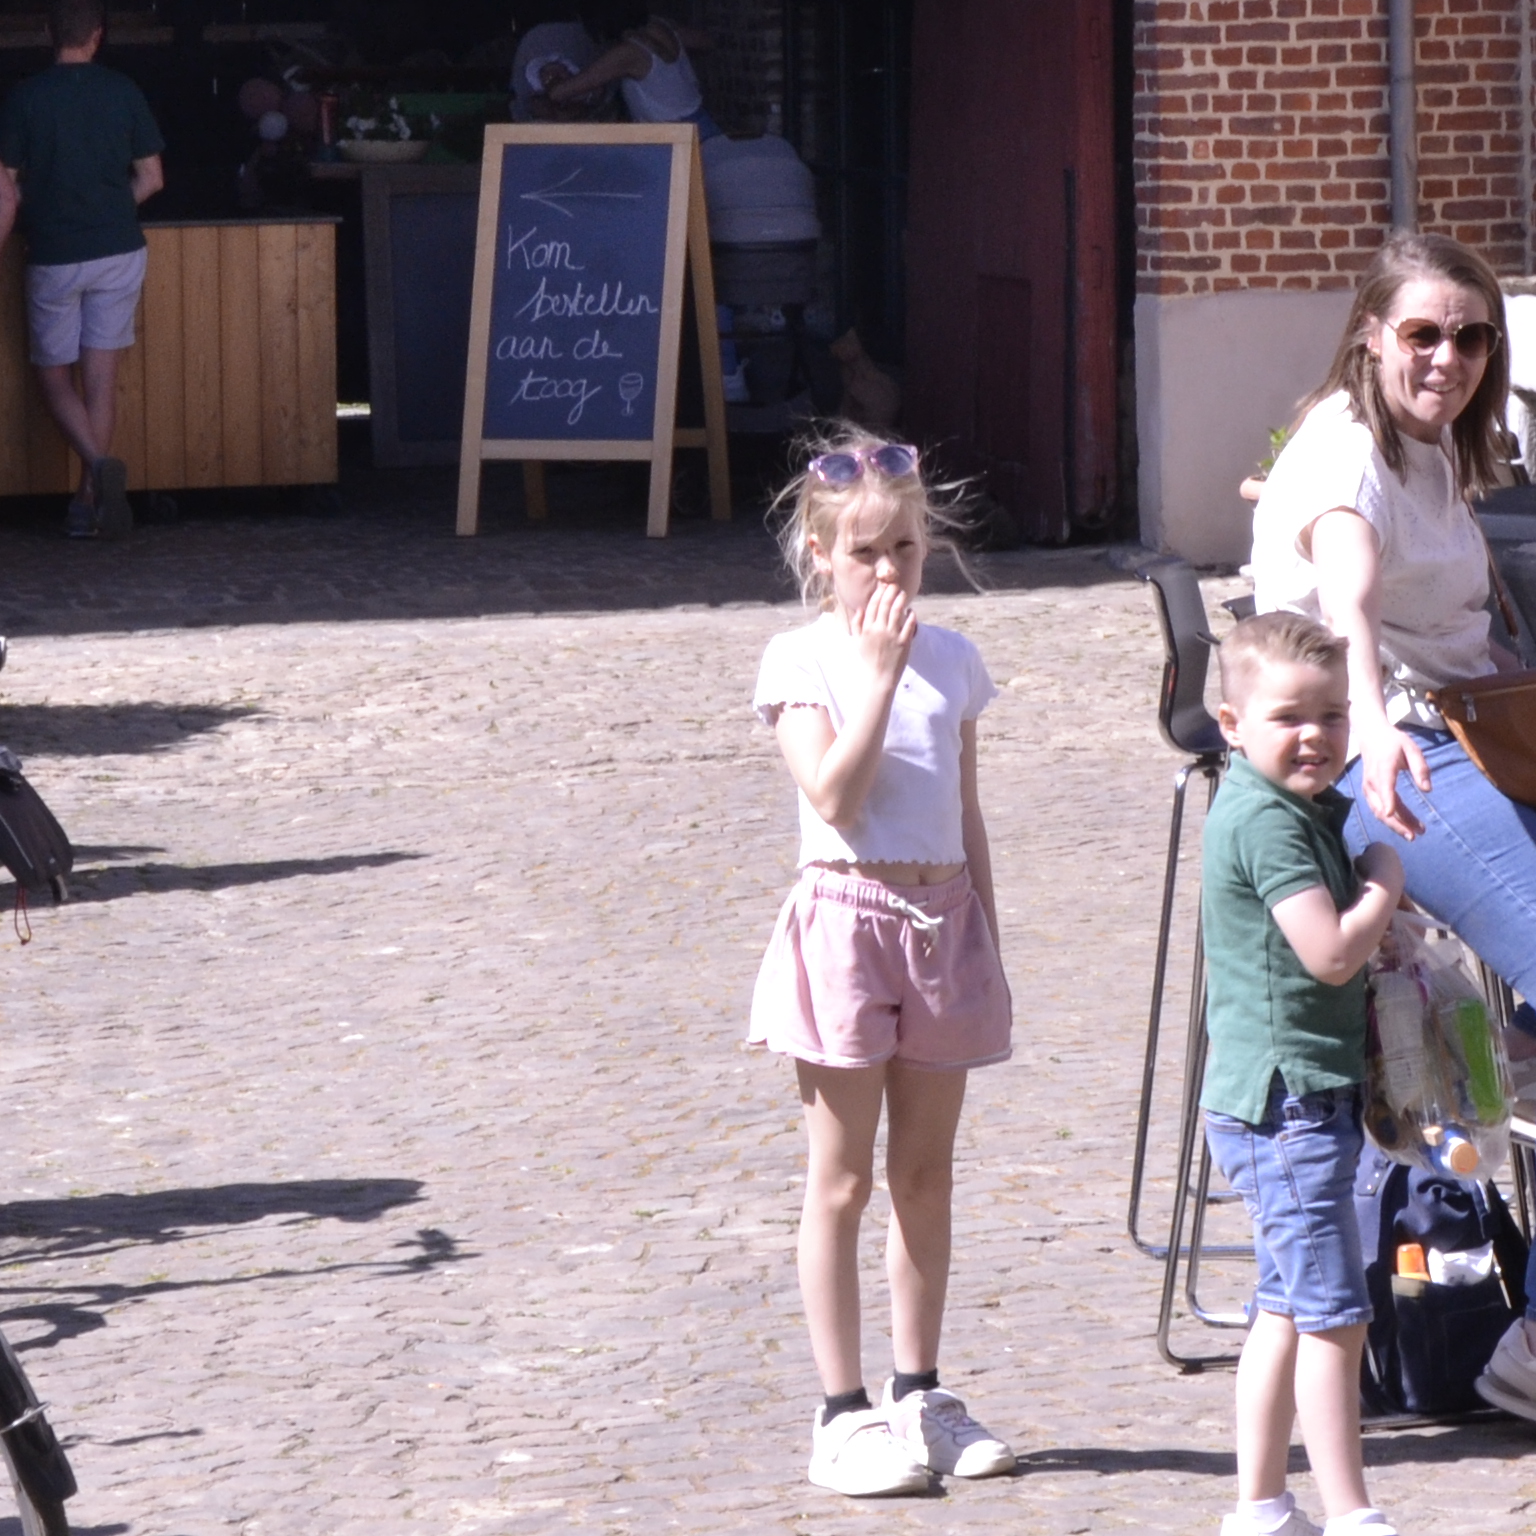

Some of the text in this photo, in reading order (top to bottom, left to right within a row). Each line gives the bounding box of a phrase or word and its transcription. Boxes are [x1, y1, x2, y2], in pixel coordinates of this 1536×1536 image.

[506, 224, 585, 270] Kom
[515, 276, 659, 322] bestellen
[496, 330, 623, 361] aan de
[510, 369, 603, 425] toog
